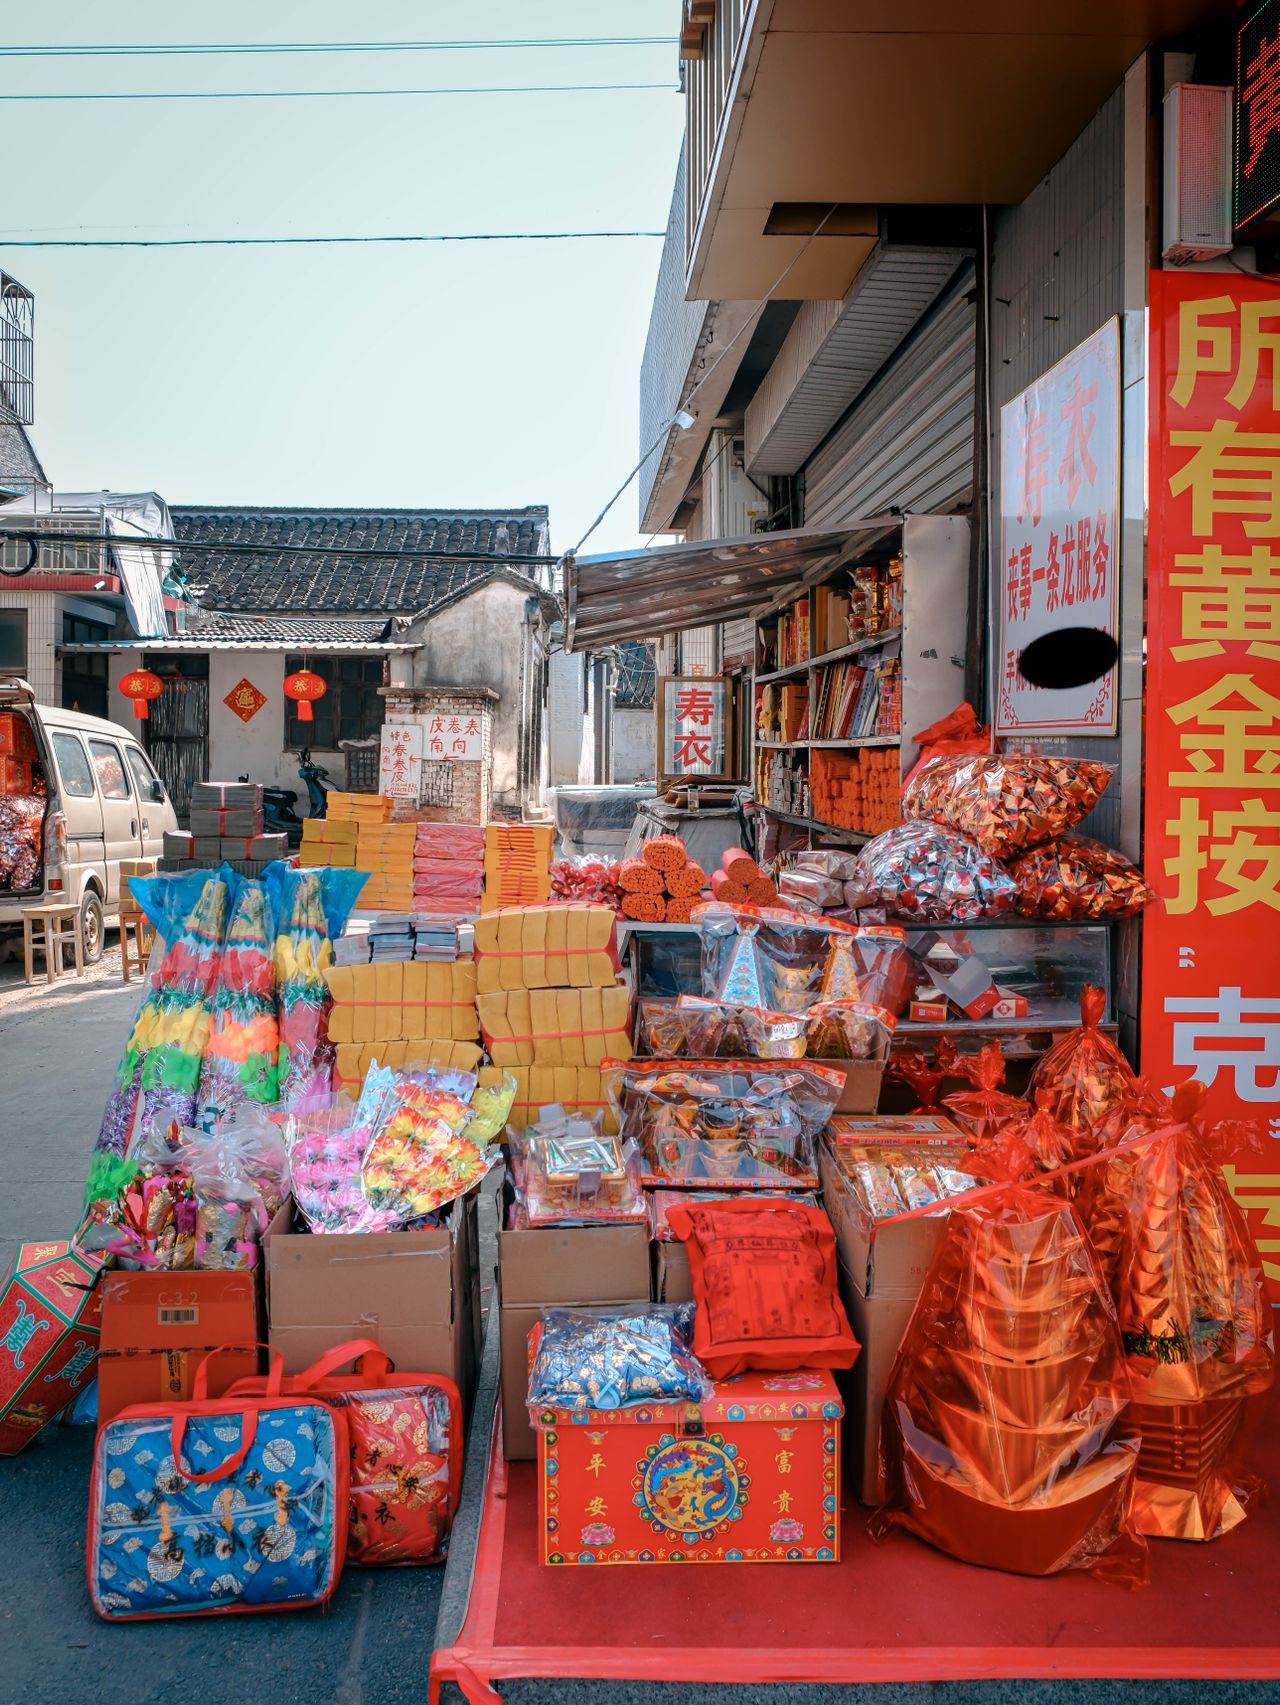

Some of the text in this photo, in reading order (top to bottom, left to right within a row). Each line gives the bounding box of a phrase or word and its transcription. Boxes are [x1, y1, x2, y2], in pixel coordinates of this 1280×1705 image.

[1016, 373, 1099, 527] 寿衣
[1007, 510, 1110, 623] 丧事一条龙服务
[673, 688, 715, 768] 寿衣
[158, 1291, 199, 1306] C-3-2
[584, 1453, 608, 1517] 平安
[773, 1449, 795, 1514] 富贵
